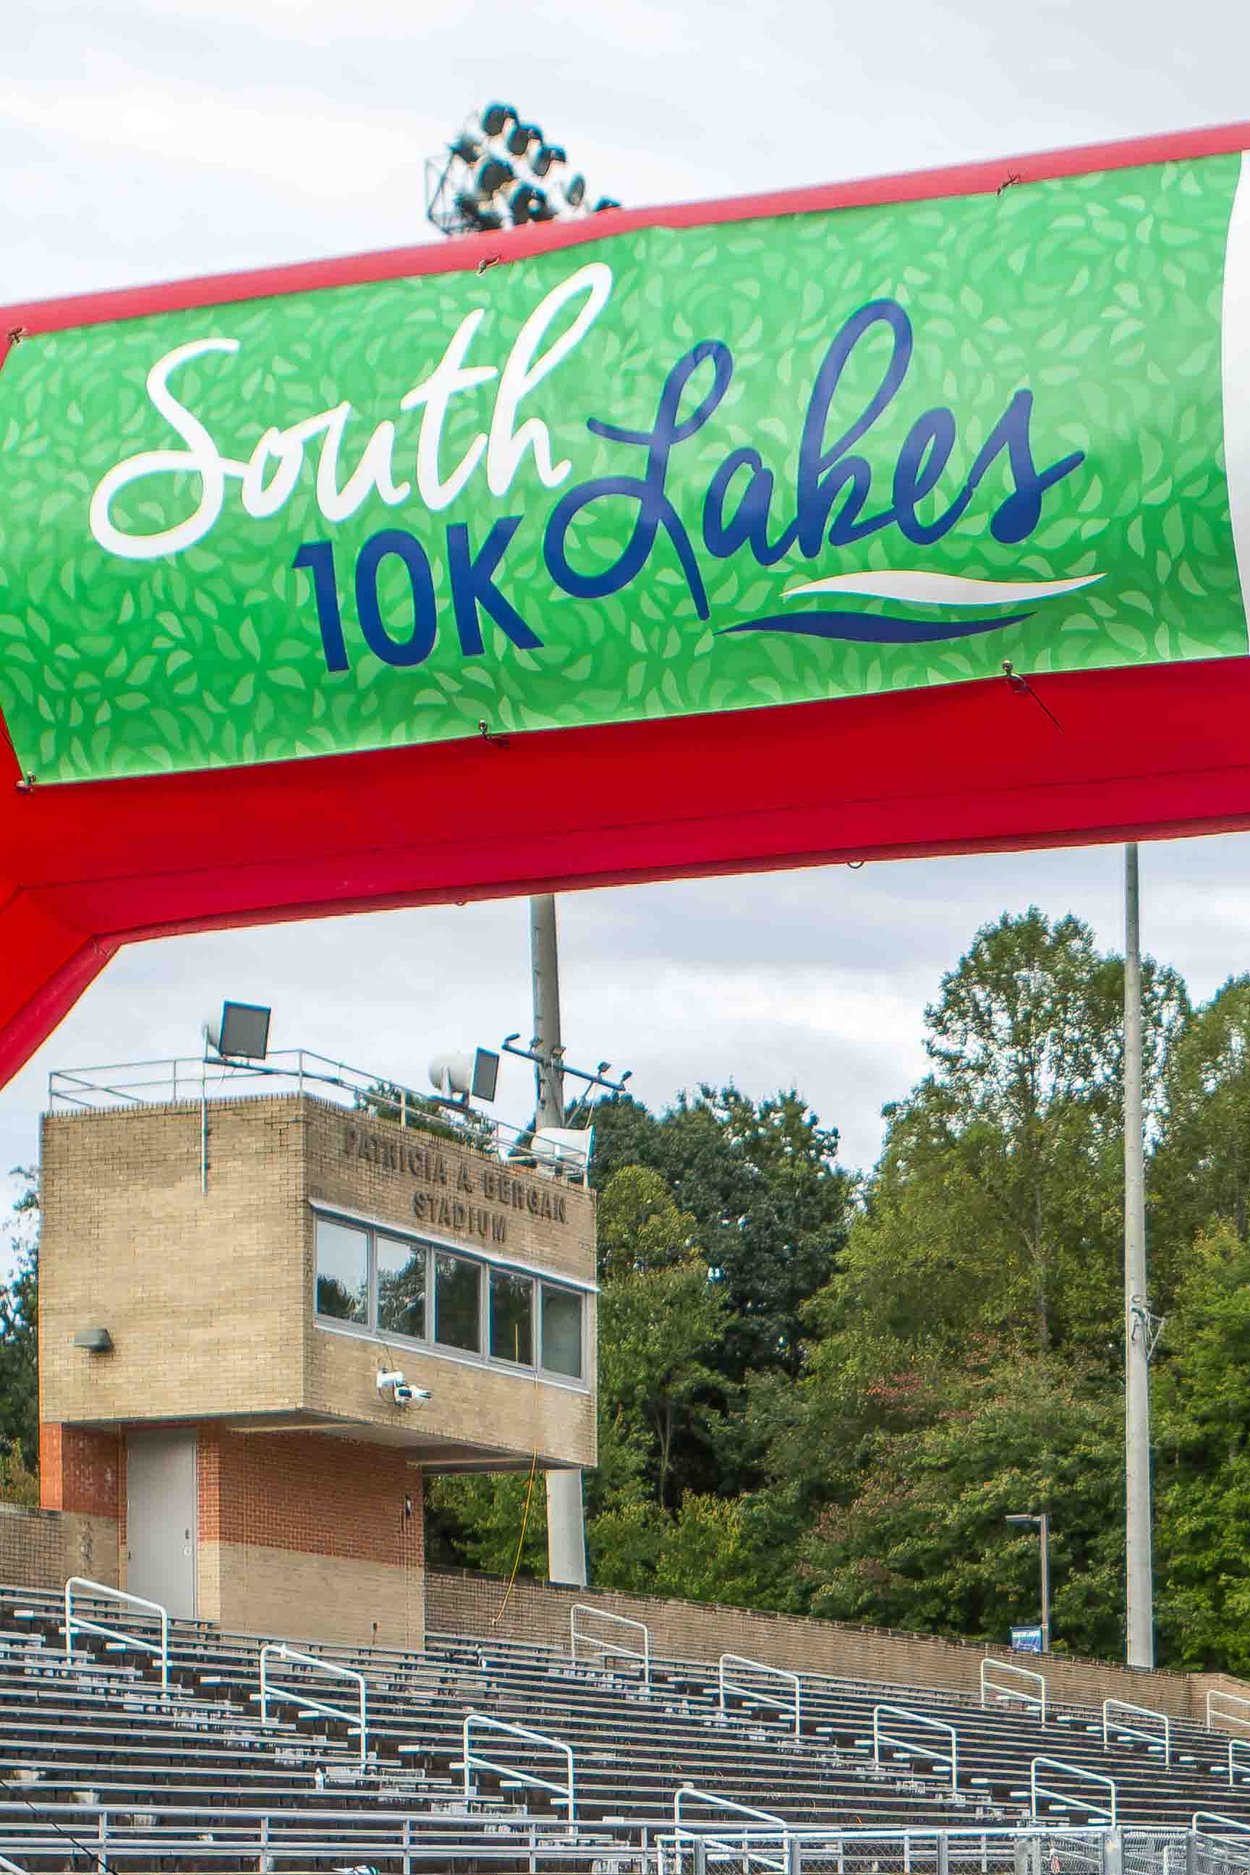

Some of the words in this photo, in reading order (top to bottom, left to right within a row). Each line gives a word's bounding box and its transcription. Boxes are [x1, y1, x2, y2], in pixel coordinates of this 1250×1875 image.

[90, 263, 613, 560] South
[544, 297, 1086, 620] Lakes
[293, 514, 545, 673] 10K
[344, 1124, 448, 1185] PATRICIA
[411, 1190, 508, 1243] STADIUM
